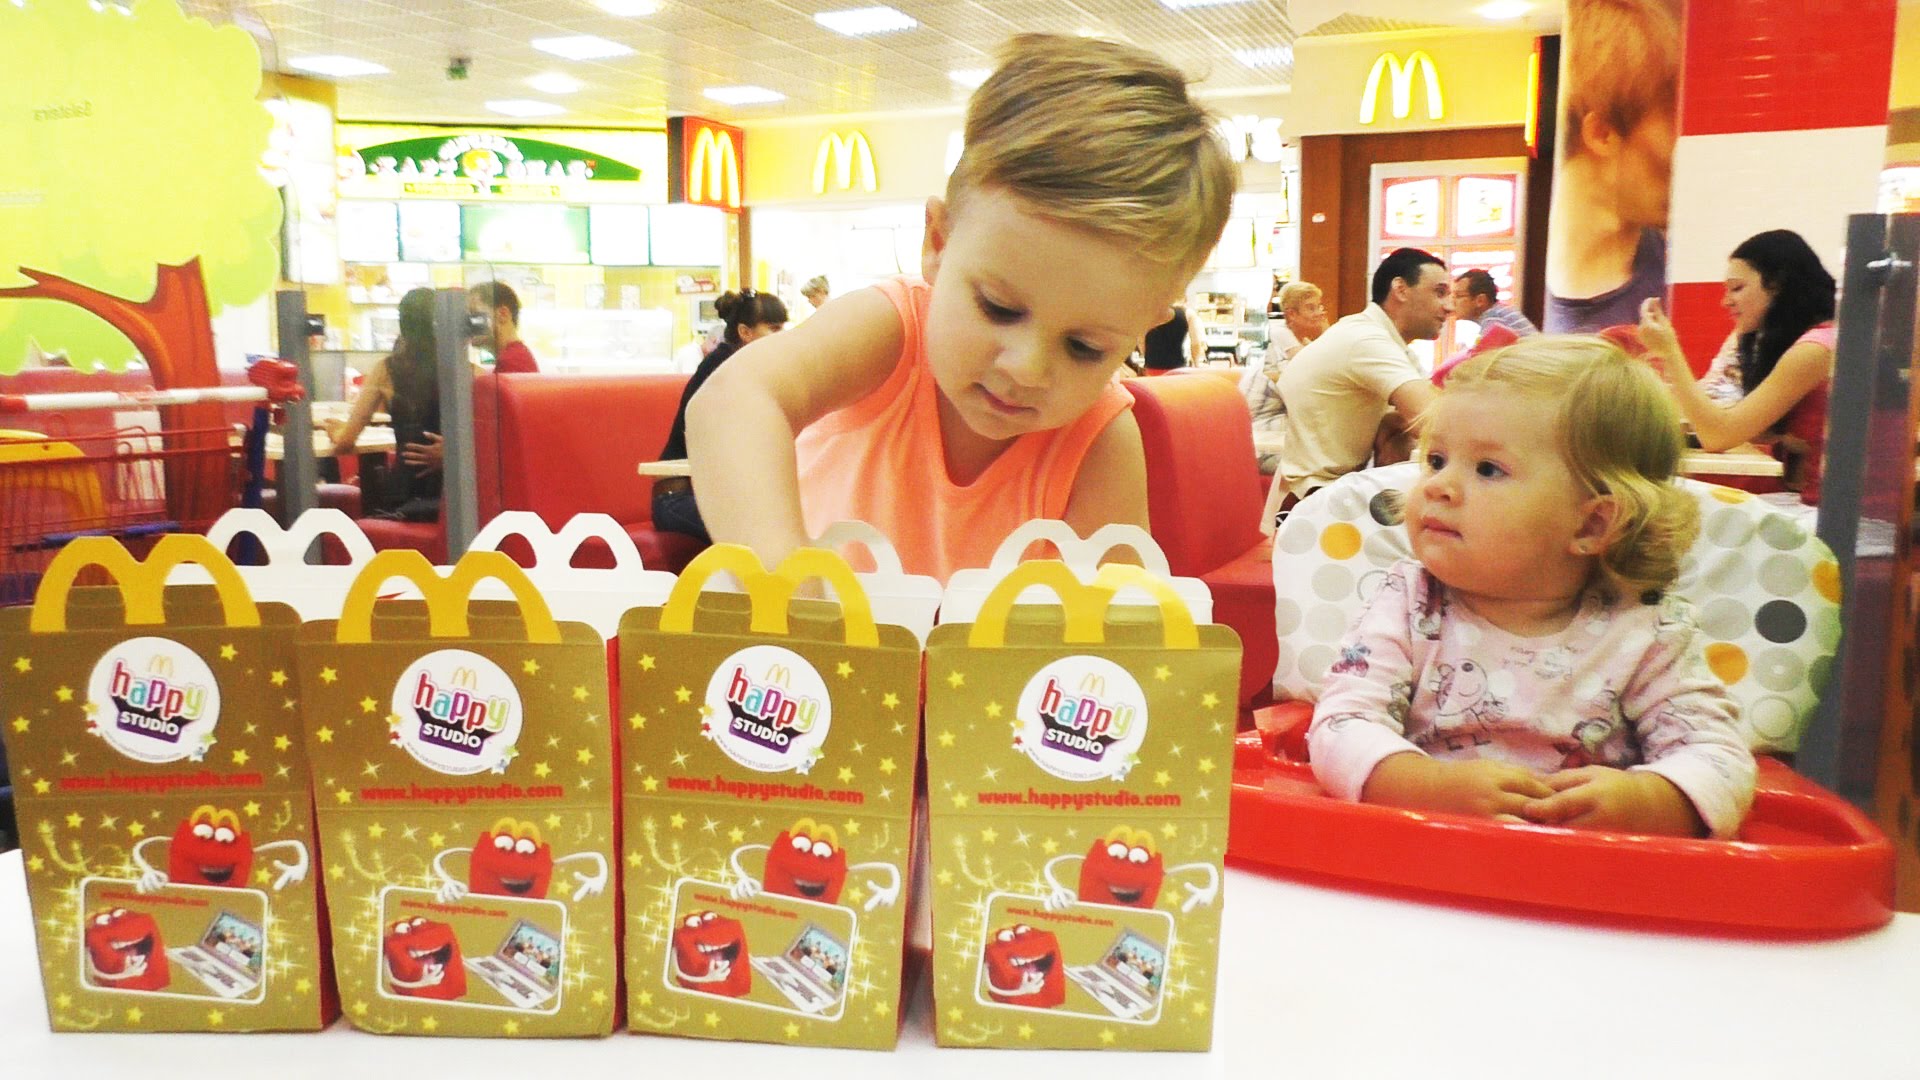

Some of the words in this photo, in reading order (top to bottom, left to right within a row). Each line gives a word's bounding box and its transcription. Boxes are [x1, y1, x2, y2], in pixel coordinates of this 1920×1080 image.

[111, 660, 206, 718] happy
[414, 672, 509, 730] happy
[727, 667, 818, 731] happy
[1039, 678, 1134, 738] happy
[119, 711, 180, 736] STUDIO
[422, 723, 482, 748] STUDIO
[732, 717, 790, 746] STUDIO
[1045, 728, 1105, 755] STUDIO
[361, 783, 563, 804] www.happystudio.com
[666, 775, 864, 804] www.happystudio.com
[978, 788, 1181, 810] www.happystudio.com
